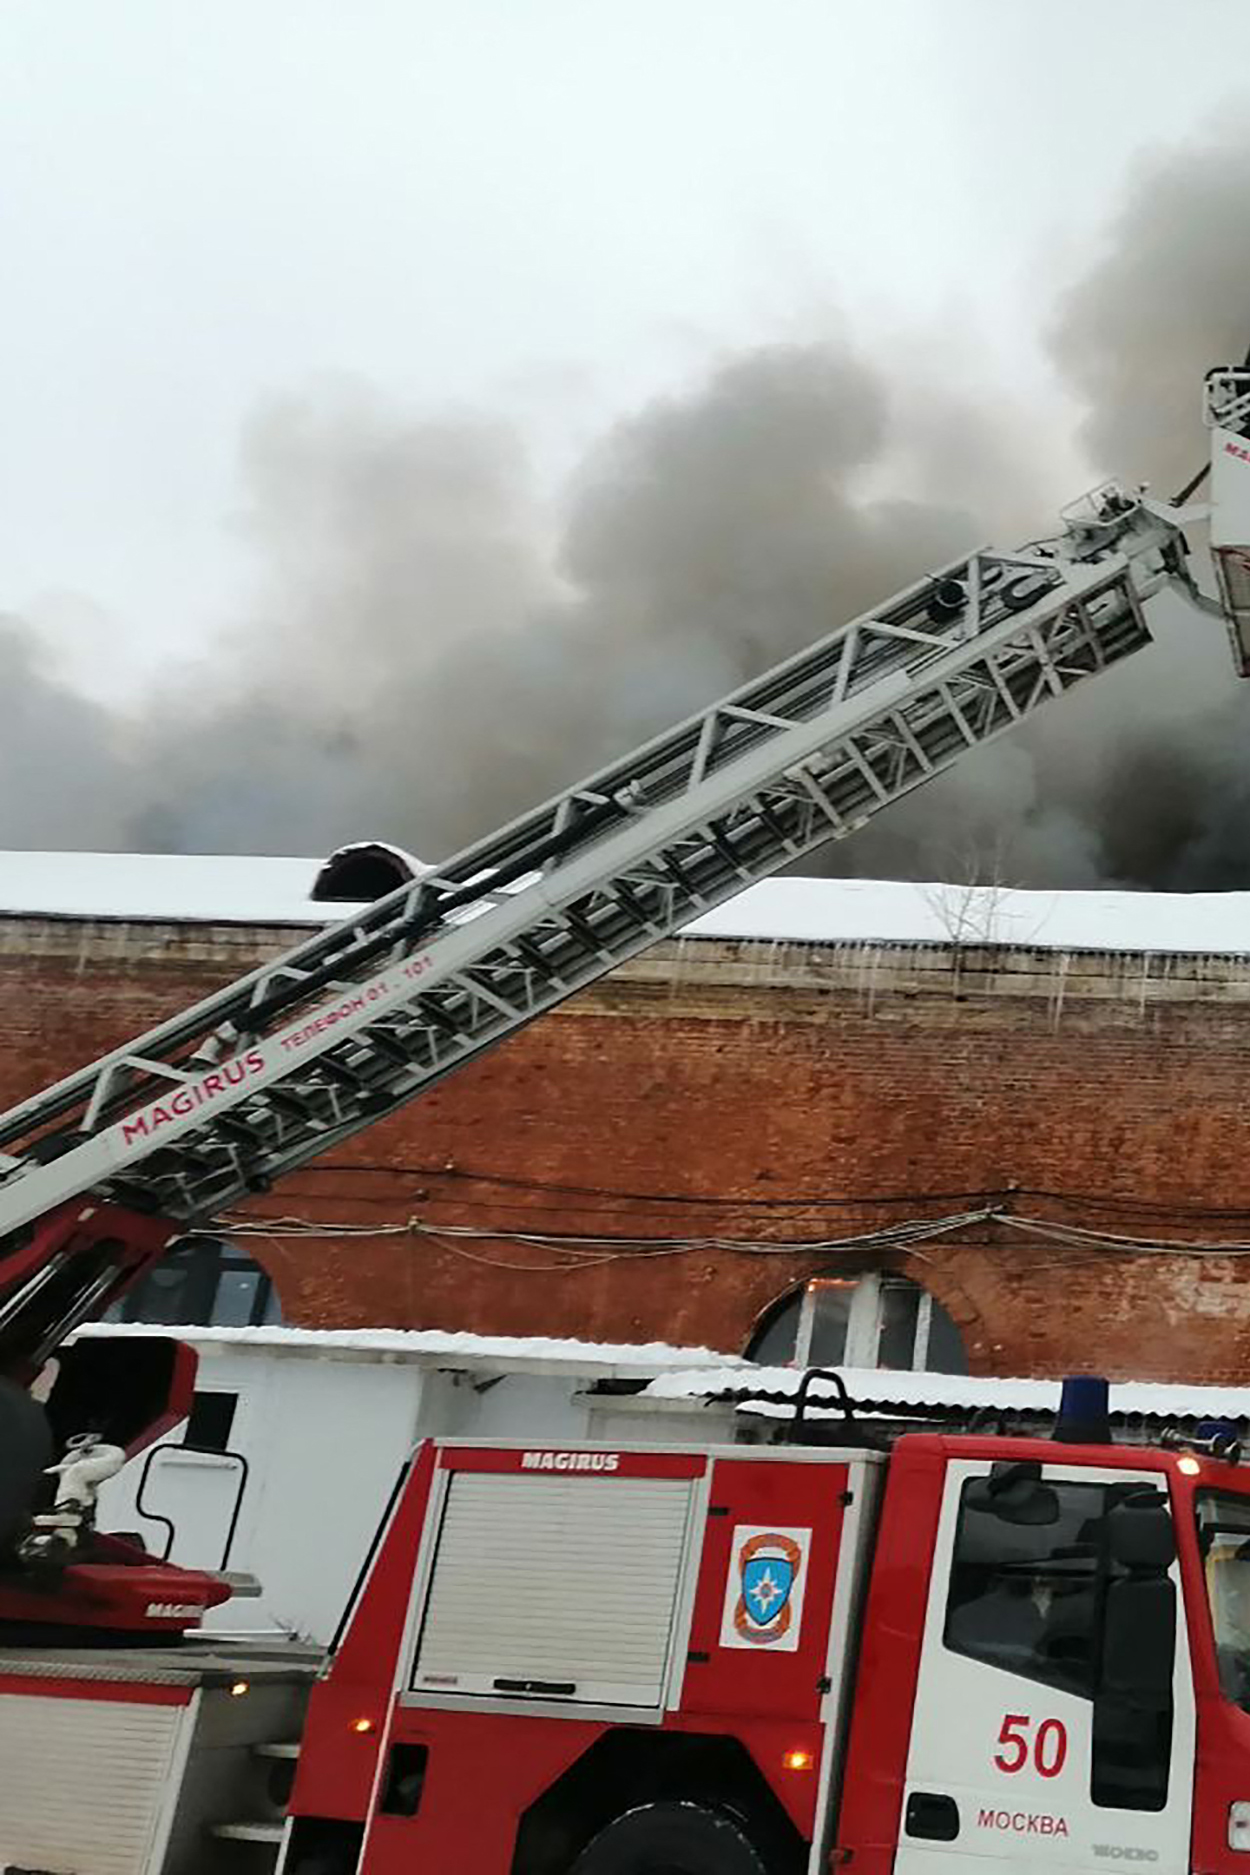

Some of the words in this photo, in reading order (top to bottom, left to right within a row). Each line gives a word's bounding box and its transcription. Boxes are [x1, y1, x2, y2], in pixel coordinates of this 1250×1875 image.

[122, 1050, 266, 1146] MAGIRUS
[521, 1452, 619, 1471] MAGIRUS
[994, 1713, 1068, 1778] 50
[977, 1808, 1069, 1837] МОСКВА
